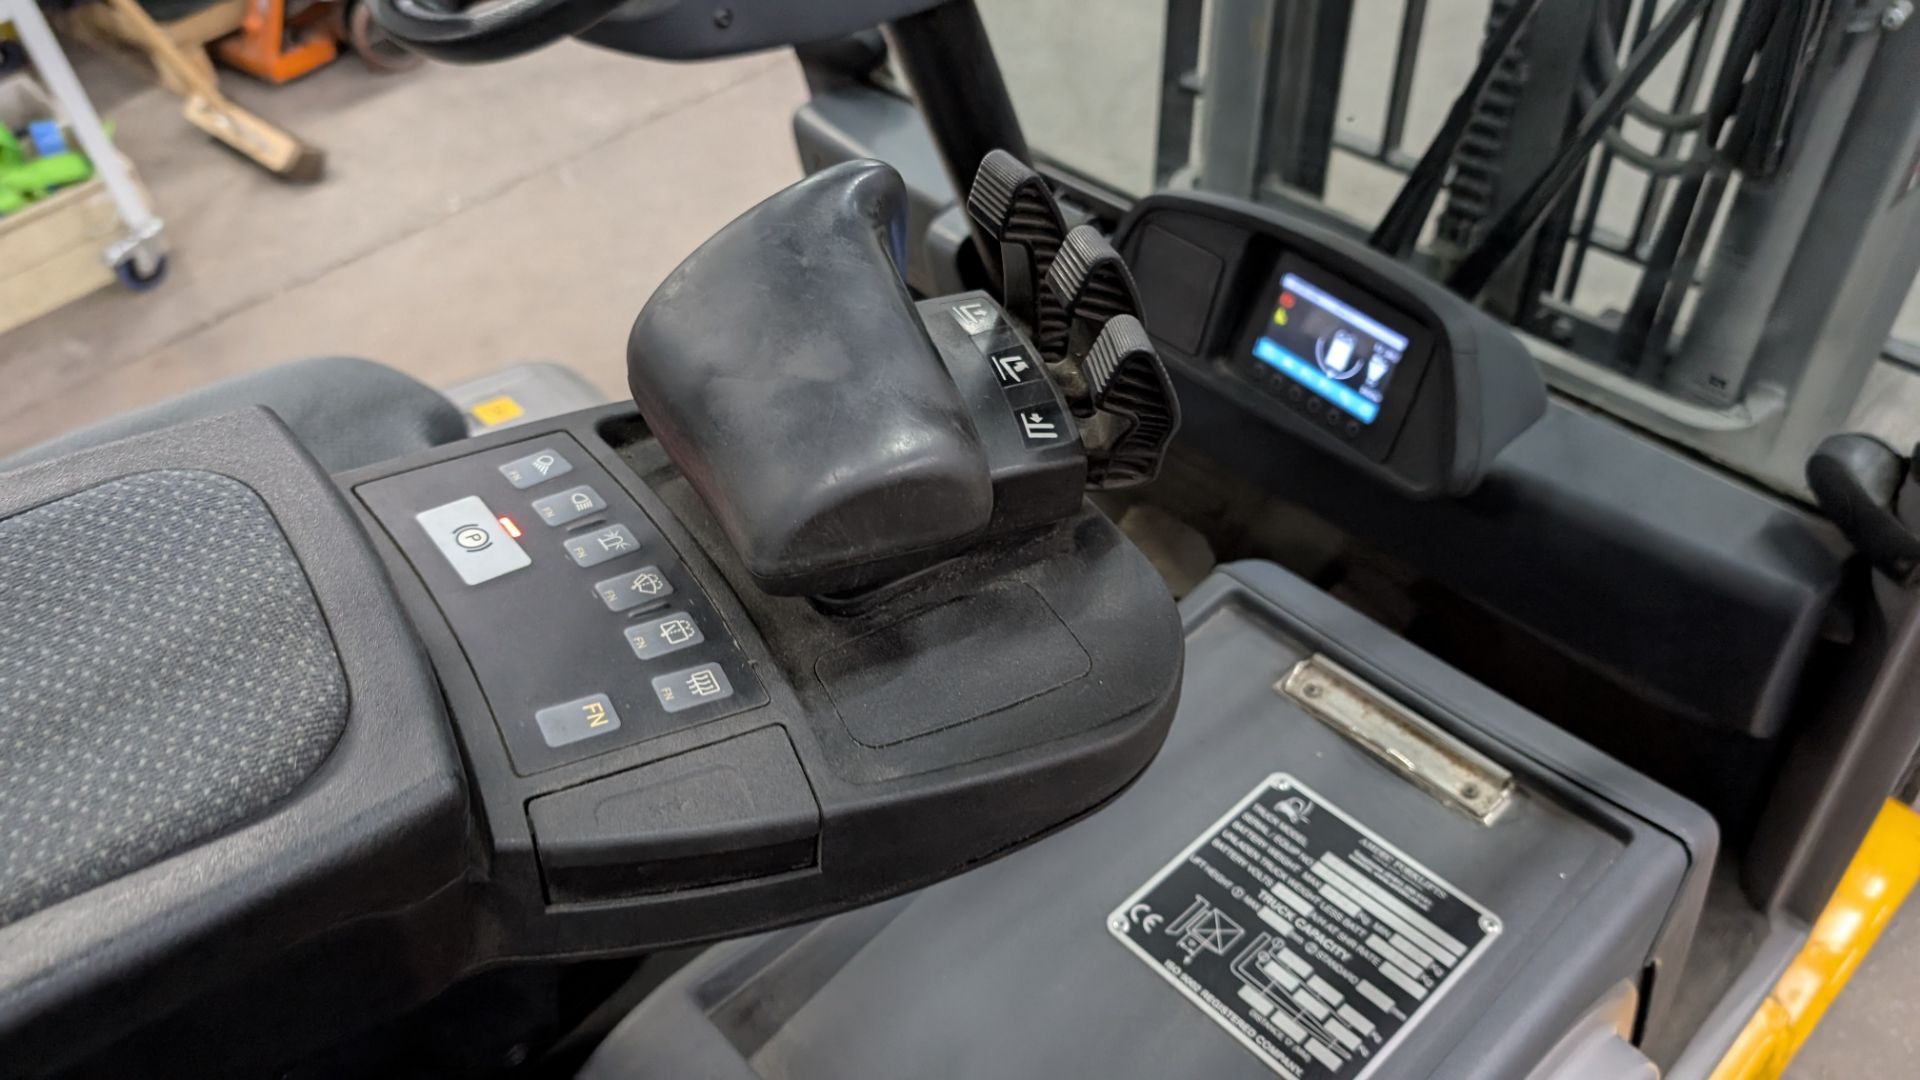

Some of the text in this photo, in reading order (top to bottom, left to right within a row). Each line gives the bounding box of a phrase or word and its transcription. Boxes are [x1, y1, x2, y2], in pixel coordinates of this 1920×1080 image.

[604, 590, 618, 602] FN
[634, 636, 648, 649] FN
[582, 702, 609, 728] FN
[661, 687, 674, 700] FN
[1240, 811, 1273, 835] SERIAL
[1271, 833, 1303, 857] EQUIP
[1250, 802, 1311, 847] TRUCK MODEL
[1219, 828, 1263, 861] UNLADEN
[1257, 856, 1290, 881] TRUCK
[1284, 876, 1323, 905] WEIGHT
[1318, 900, 1346, 922] LESS
[1230, 820, 1269, 849] BATTERY
[1265, 845, 1302, 873] WEIGHT
[1299, 870, 1323, 889] MAX
[1371, 921, 1393, 938] MIN
[1124, 900, 1166, 934] CE
[1187, 853, 1207, 869] LIFT
[1202, 864, 1234, 889] HEIGHT
[1241, 894, 1262, 911] MAX
[1313, 949, 1360, 986] STANDARD
[1209, 837, 1250, 868] BATTERY
[1244, 863, 1276, 887] VOLTS
[1323, 921, 1339, 935] AT
[1354, 944, 1383, 967] RATE
[1255, 889, 1352, 963] TRUCK CAPACITY
[1162, 958, 1183, 976] ISO
[1198, 988, 1258, 1038] REGISTERED
[1246, 1008, 1286, 1041] DISTANCE
